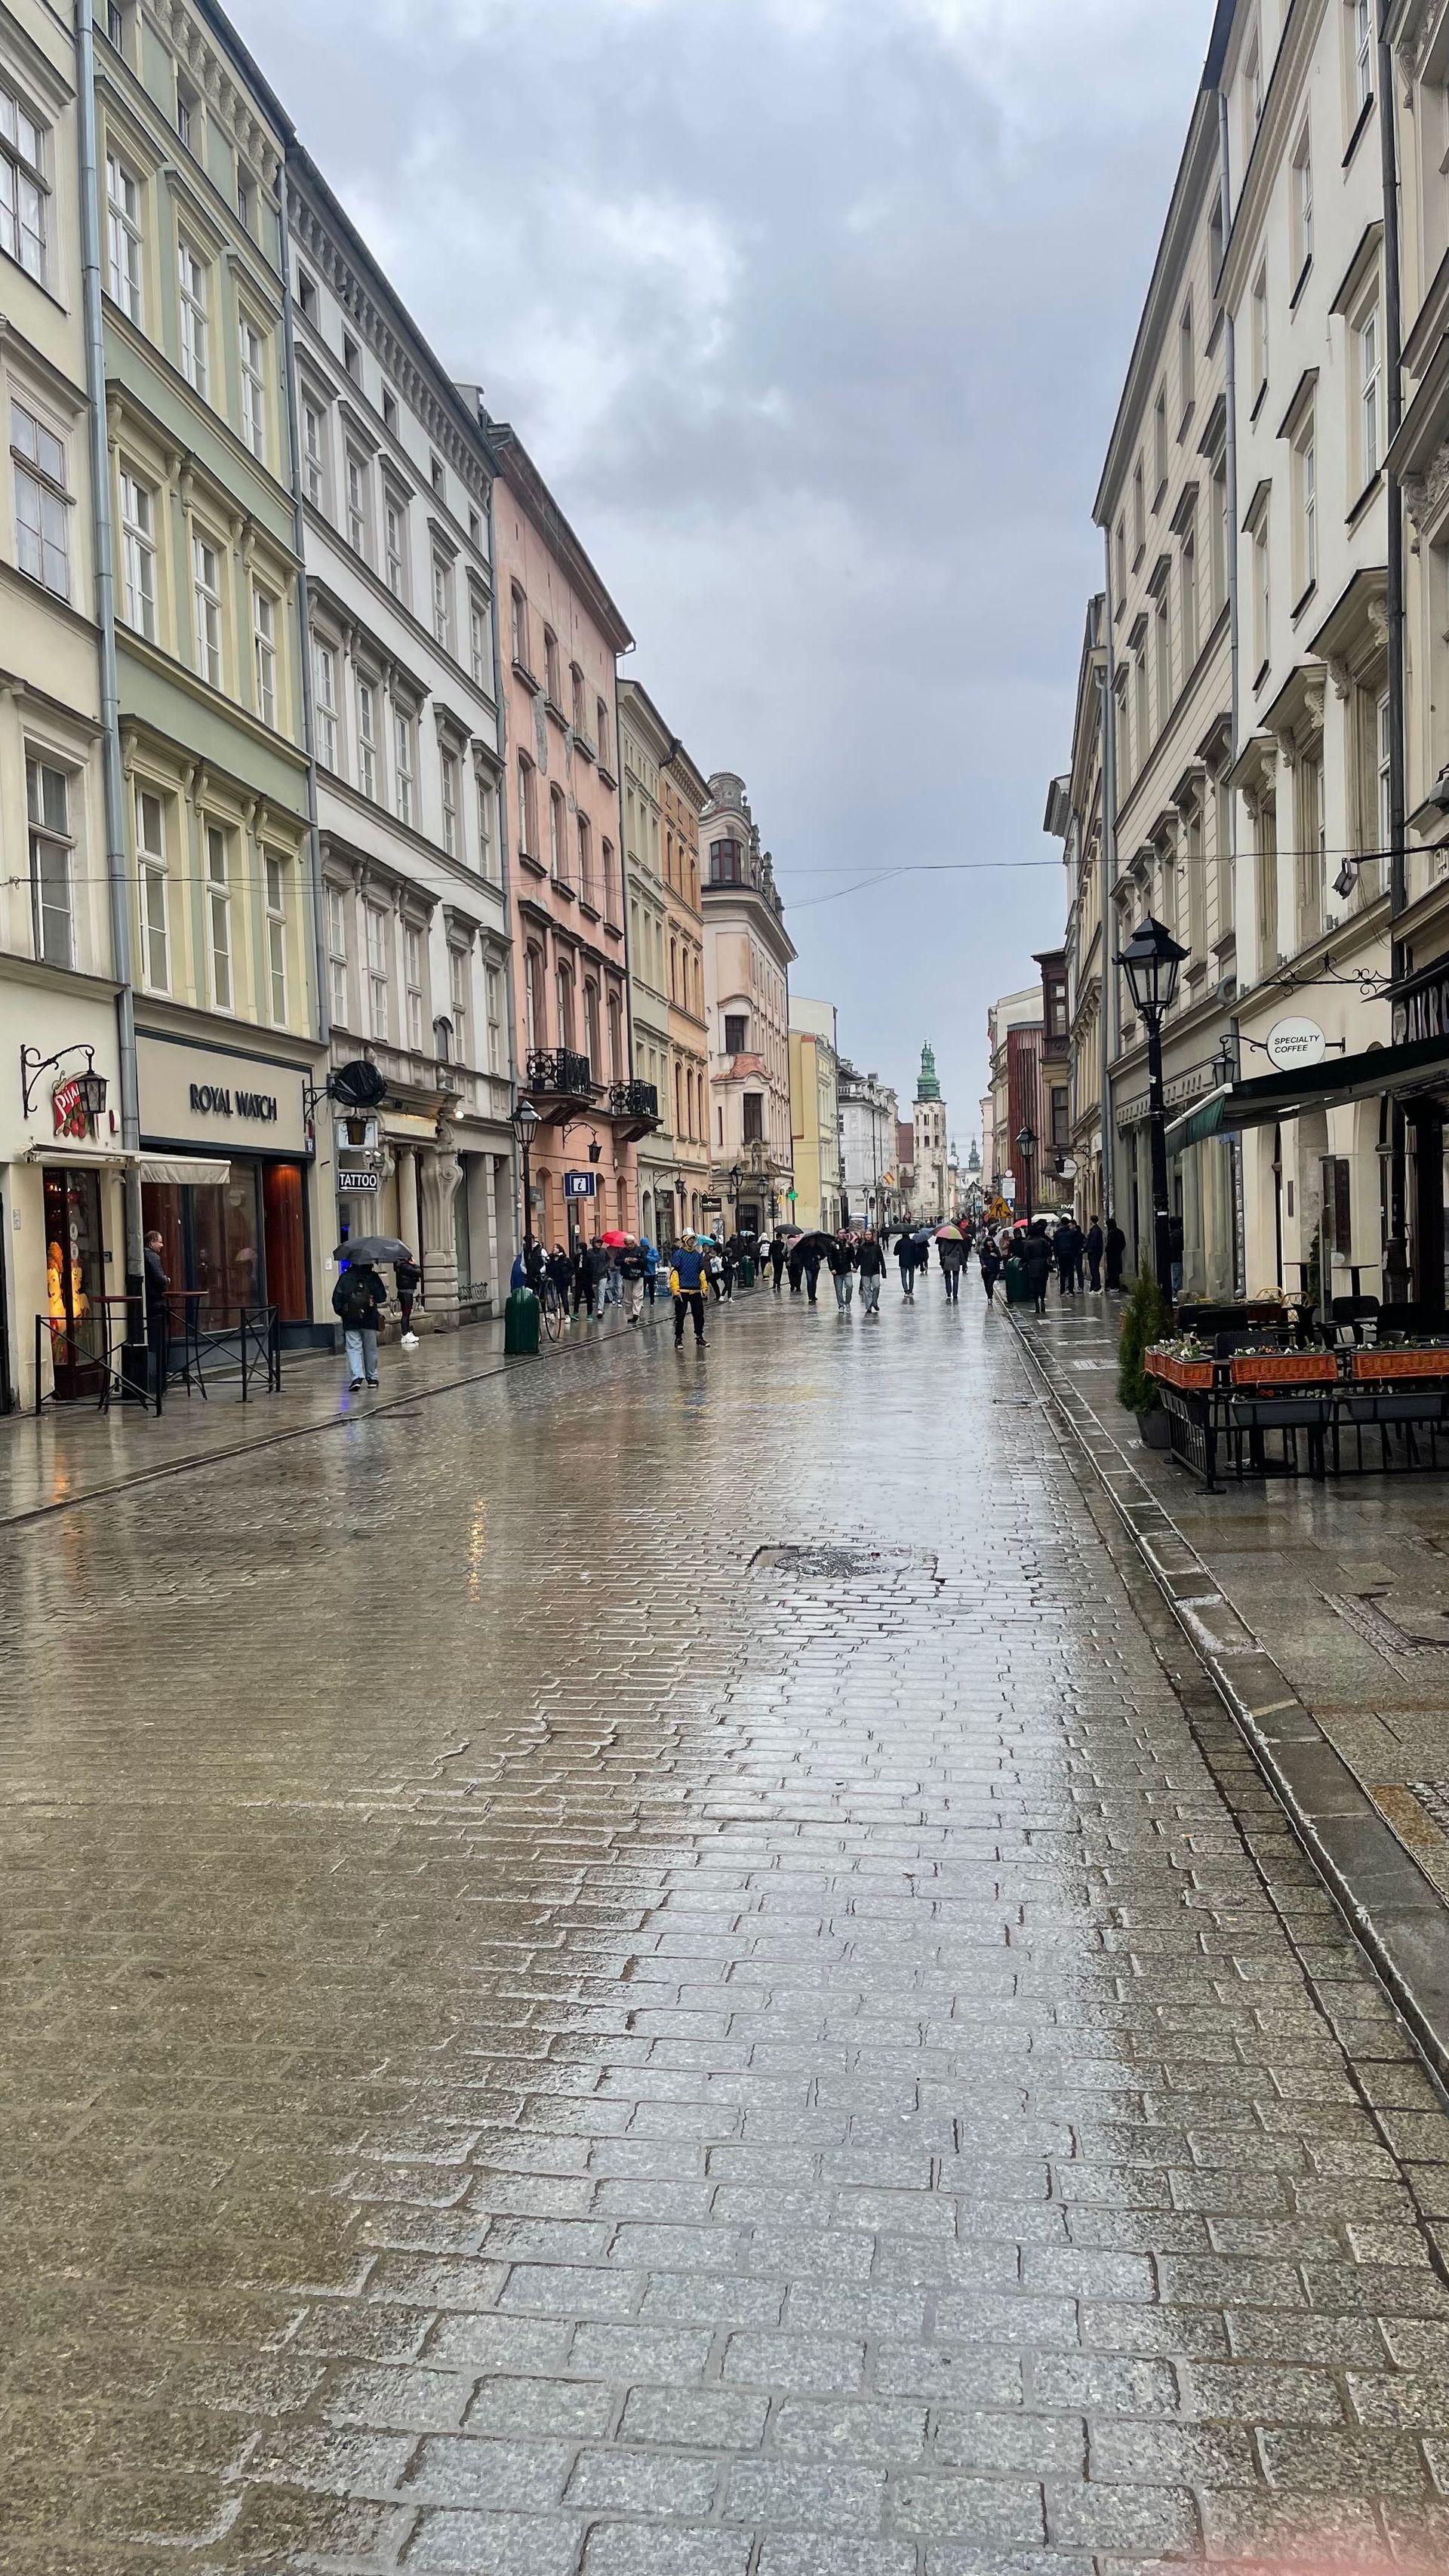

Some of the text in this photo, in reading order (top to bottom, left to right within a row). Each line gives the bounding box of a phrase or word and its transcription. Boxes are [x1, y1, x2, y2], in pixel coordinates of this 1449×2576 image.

[1274, 1035, 1320, 1045] SPECIALTY
[1275, 1045, 1309, 1054] COFFEE
[189, 1083, 277, 1121] ROYAL WATCH
[339, 1174, 377, 1187] TATTOO
